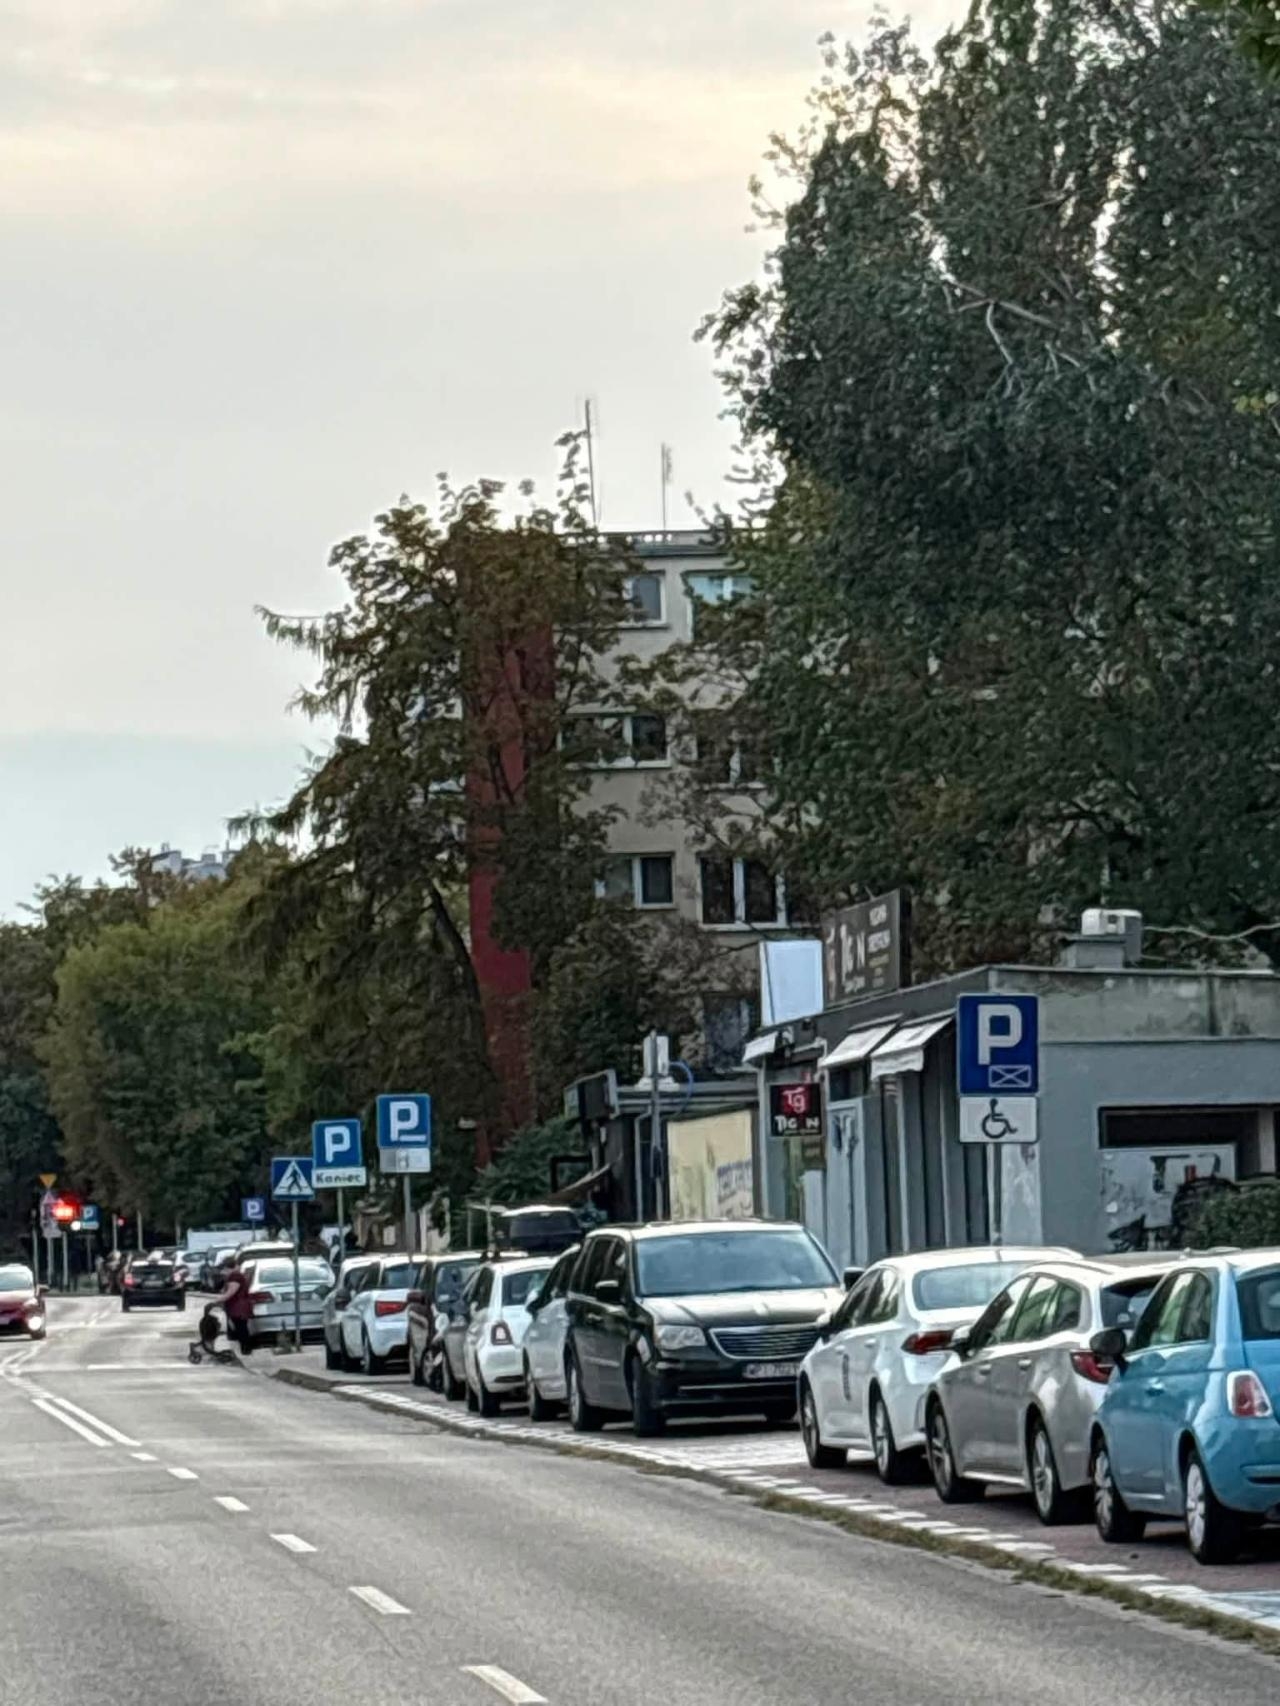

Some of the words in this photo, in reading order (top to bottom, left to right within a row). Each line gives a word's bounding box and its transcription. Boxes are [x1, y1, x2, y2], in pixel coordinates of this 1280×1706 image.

[977, 1003, 1022, 1066] P
[782, 1086, 805, 1114] Tg
[389, 1101, 419, 1142] P
[324, 1126, 351, 1163] P
[83, 1206, 94, 1220] P
[247, 1200, 260, 1218] P
